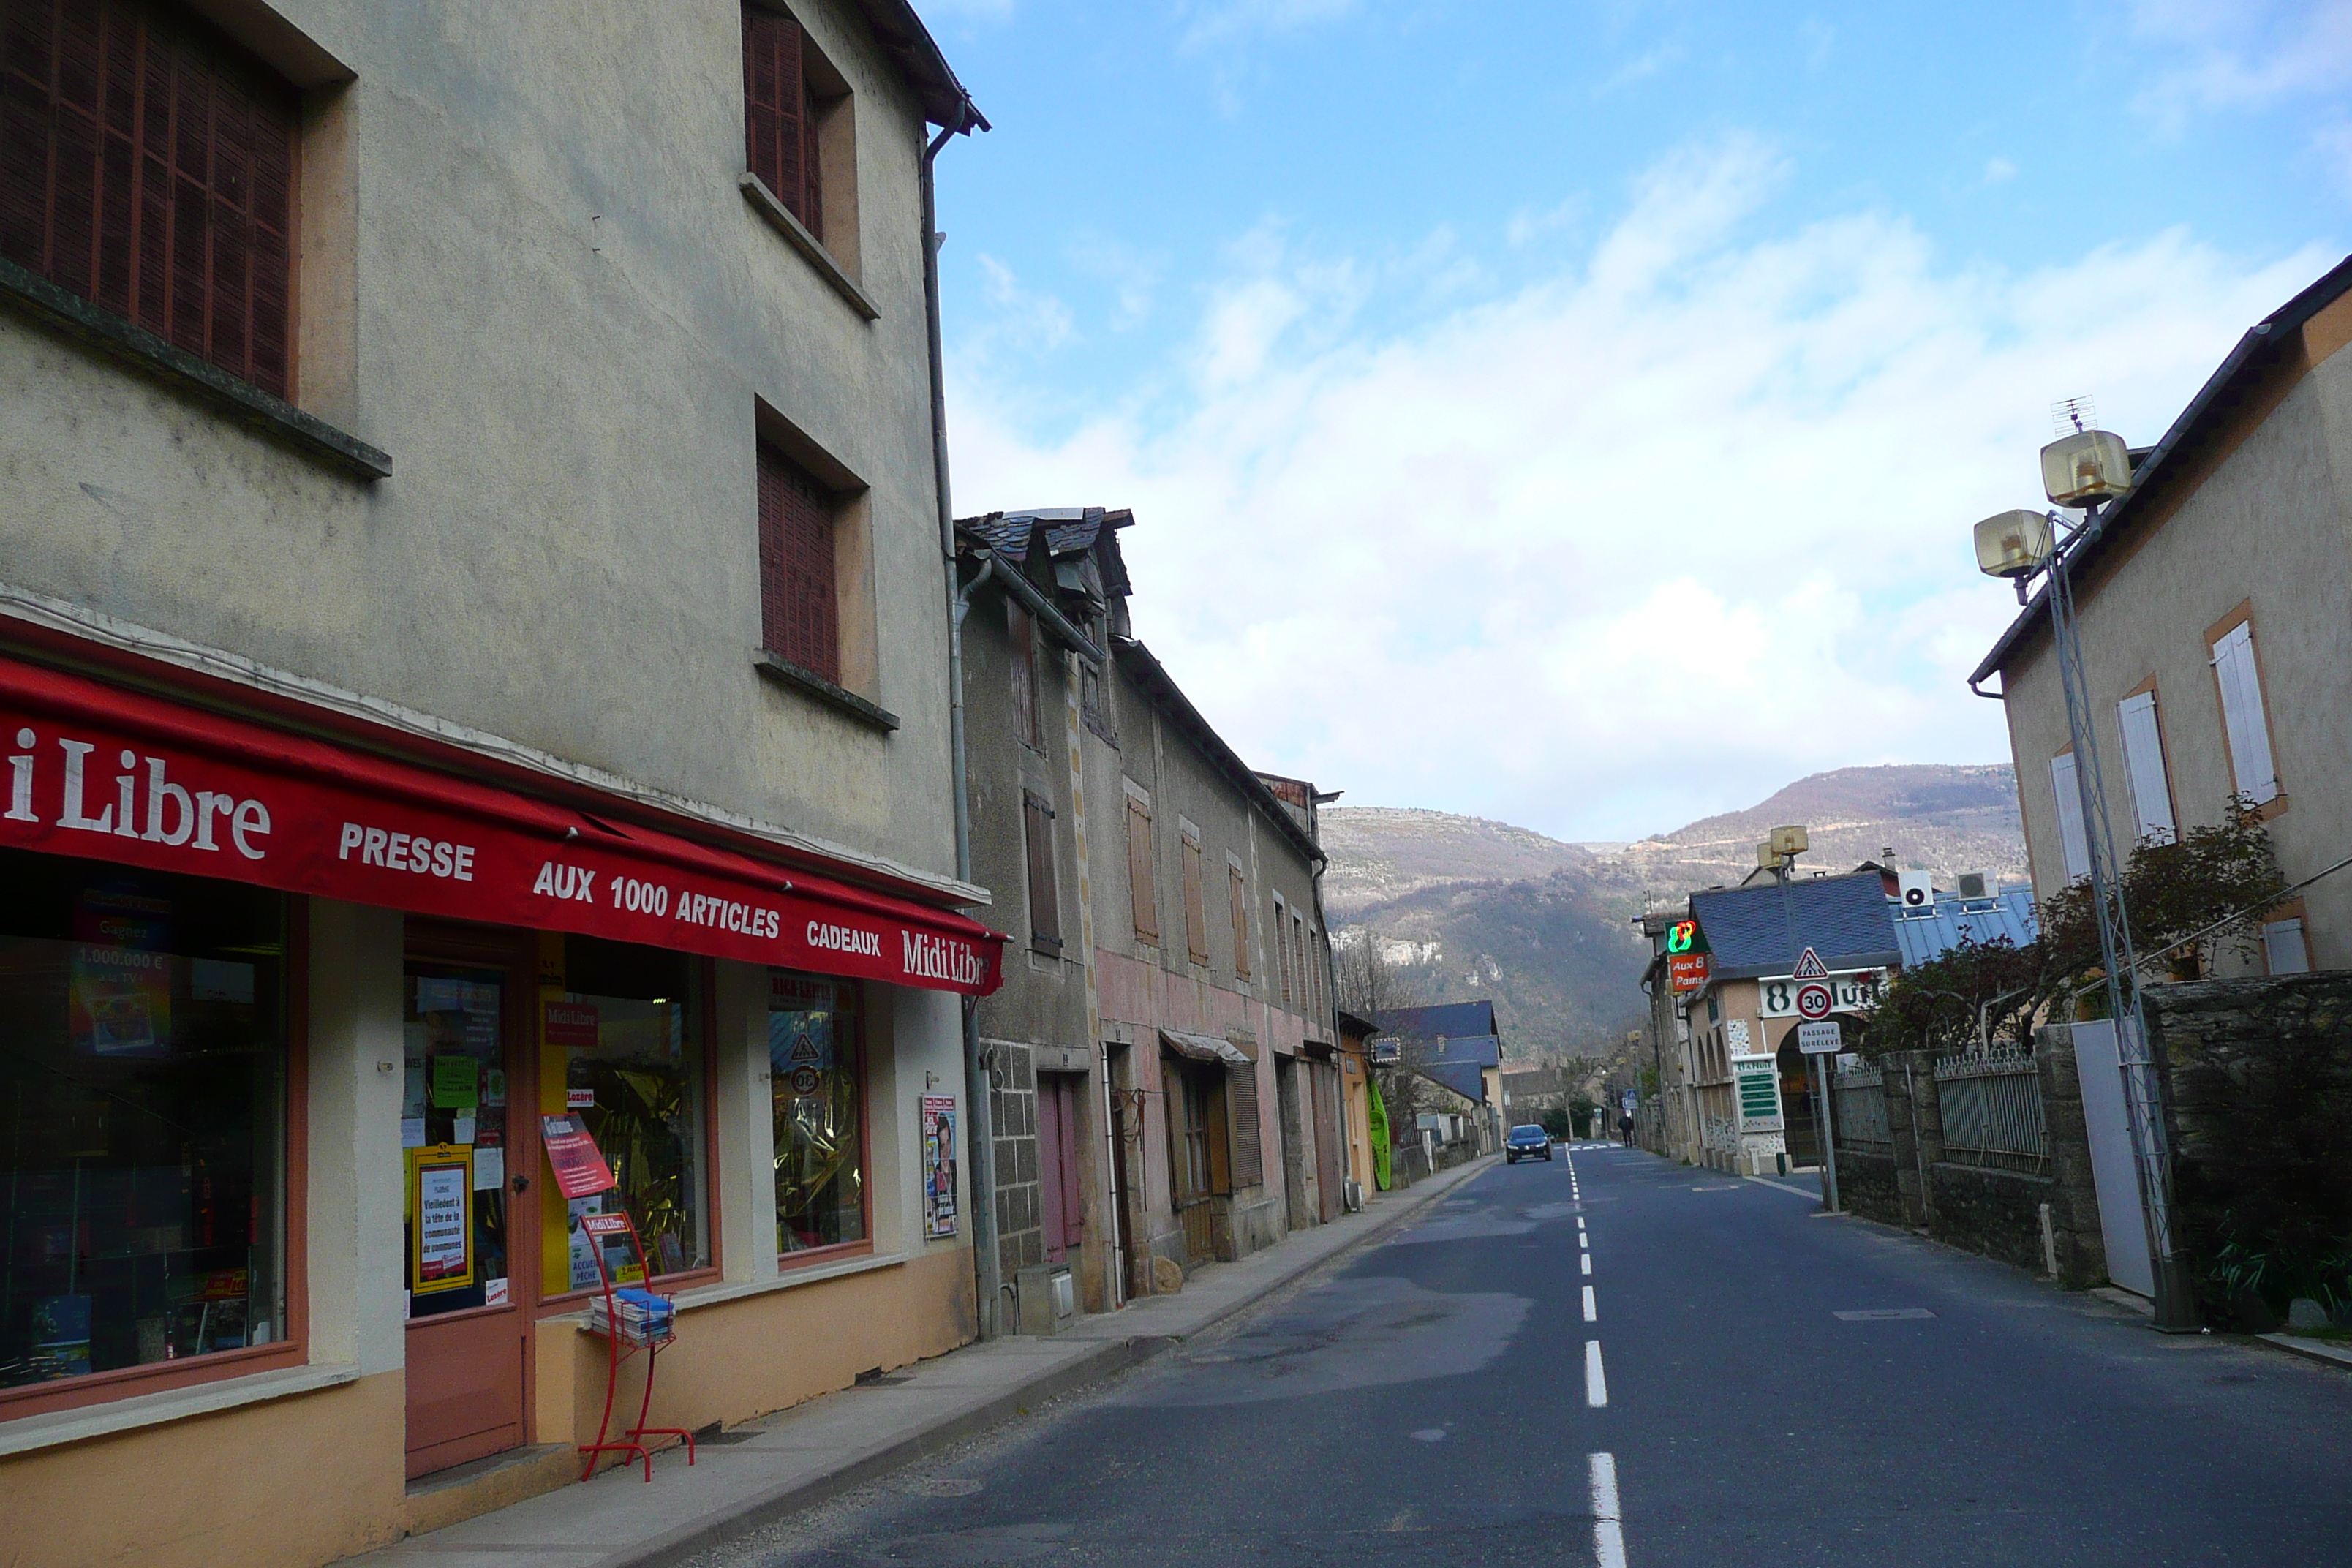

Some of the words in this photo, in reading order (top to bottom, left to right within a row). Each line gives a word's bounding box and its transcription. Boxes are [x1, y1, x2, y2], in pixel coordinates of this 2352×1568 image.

[56, 737, 271, 859] Libre
[339, 822, 475, 881] PRESSE
[534, 861, 596, 903] AUX
[611, 876, 668, 917] 1000
[675, 891, 780, 939] ARTICLES
[99, 920, 148, 940] Gagnez
[806, 920, 881, 957] CADEAUX
[80, 946, 151, 969] 1.000.000
[901, 930, 949, 980] Midi
[1673, 962, 1694, 971] Aux
[1695, 956, 1705, 969] 8
[1676, 976, 1705, 986] Pains
[1766, 981, 1791, 1013] 8
[1804, 995, 1825, 1010] 30
[548, 1009, 570, 1024] Midi
[571, 1010, 596, 1026] Libre
[1802, 1028, 1836, 1036] PASSAGE
[1801, 1038, 1840, 1047] SURÉLEVÉ
[568, 1091, 592, 1102] Lozère
[424, 1197, 455, 1210] Vieilledent
[425, 1213, 431, 1224] la
[432, 1213, 444, 1223] tête
[445, 1211, 453, 1222] de
[453, 1210, 459, 1221] la
[587, 1218, 606, 1230] Midi
[606, 1217, 625, 1229] Libre
[425, 1224, 460, 1239] communauté
[423, 1243, 430, 1253] de
[431, 1240, 461, 1253] communes
[487, 1288, 506, 1303] Lozère
